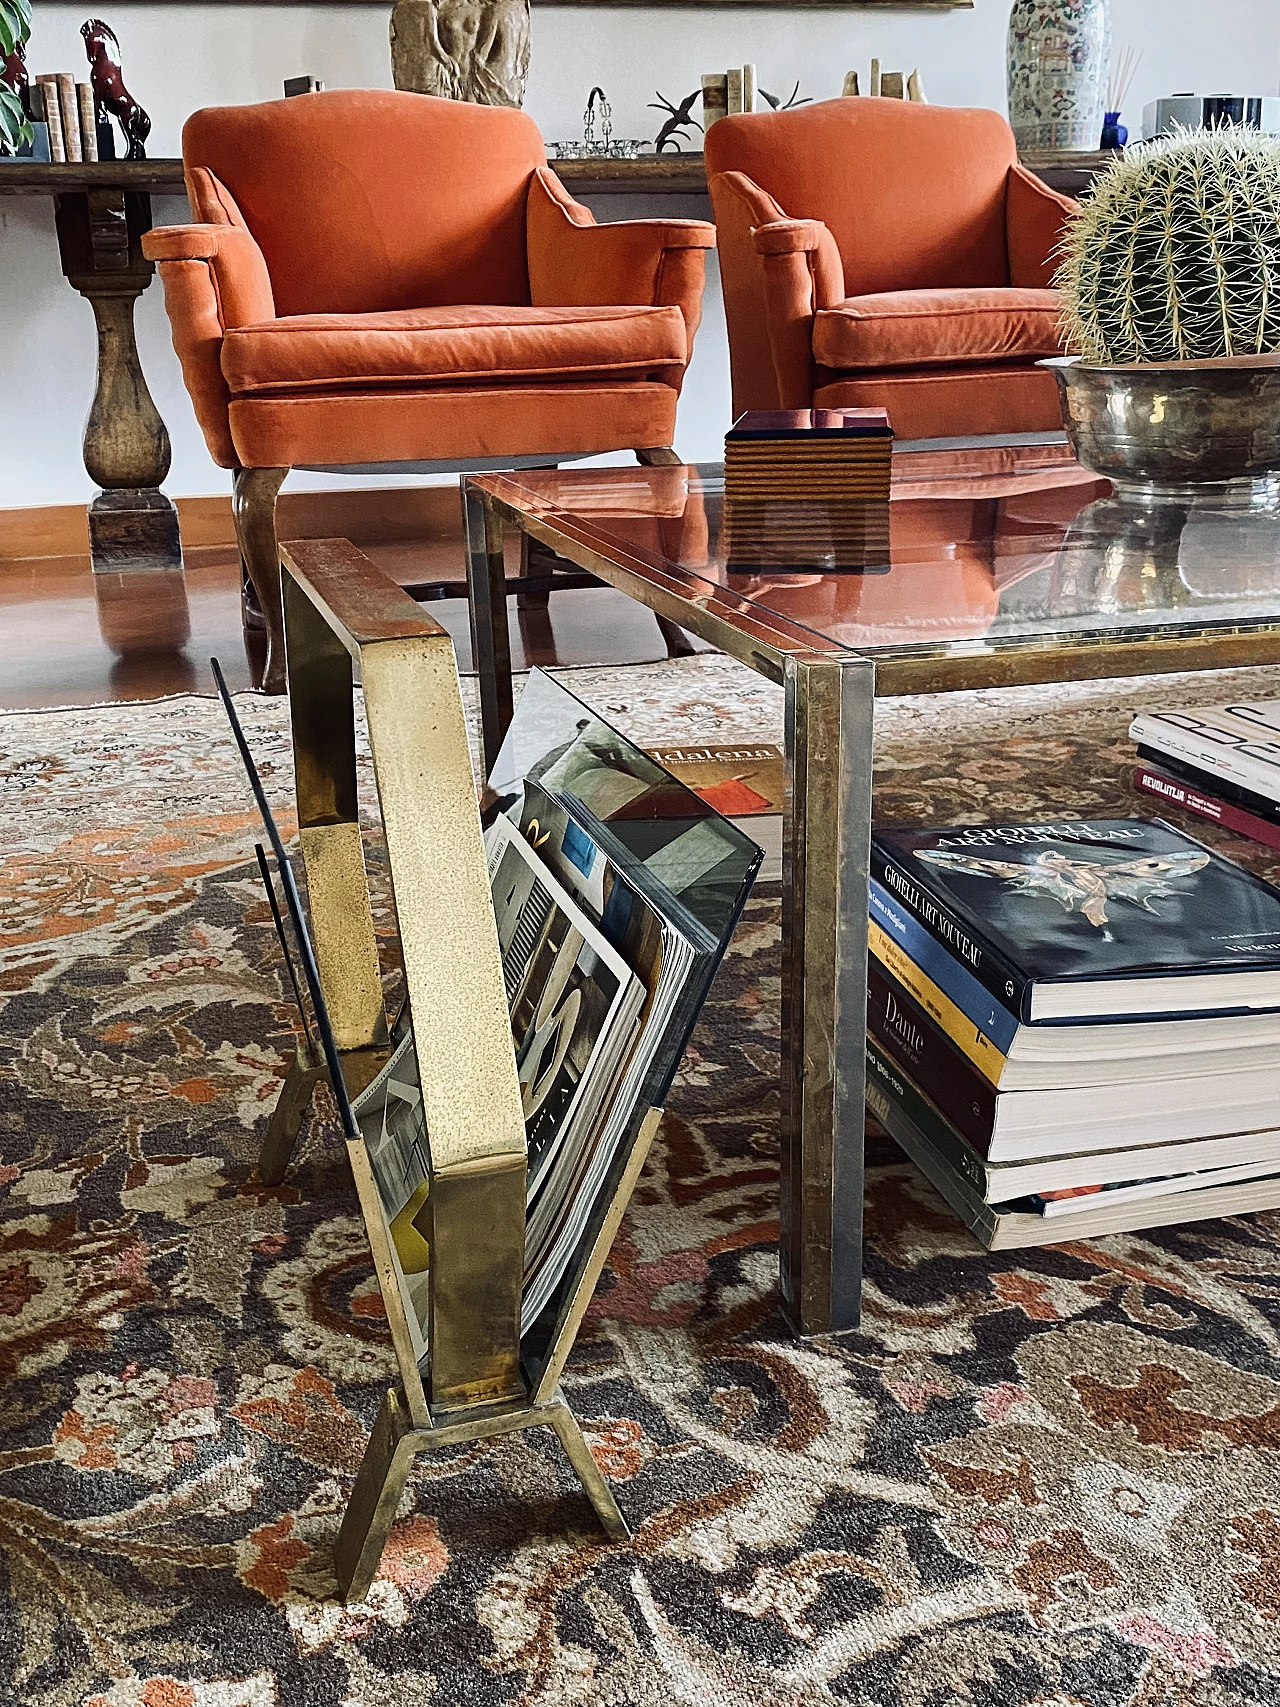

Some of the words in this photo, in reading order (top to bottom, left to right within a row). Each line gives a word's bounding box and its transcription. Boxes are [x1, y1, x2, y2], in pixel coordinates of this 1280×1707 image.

[651, 749, 773, 761] ddalena
[936, 837, 996, 847] ART
[1004, 828, 1145, 845] NOUVEAU
[962, 823, 1097, 838] GIOIELLI
[884, 864, 920, 909] GIOIELLI
[918, 897, 939, 927] ART
[937, 912, 983, 969] NOUVEAU
[885, 991, 924, 1055] Dante
